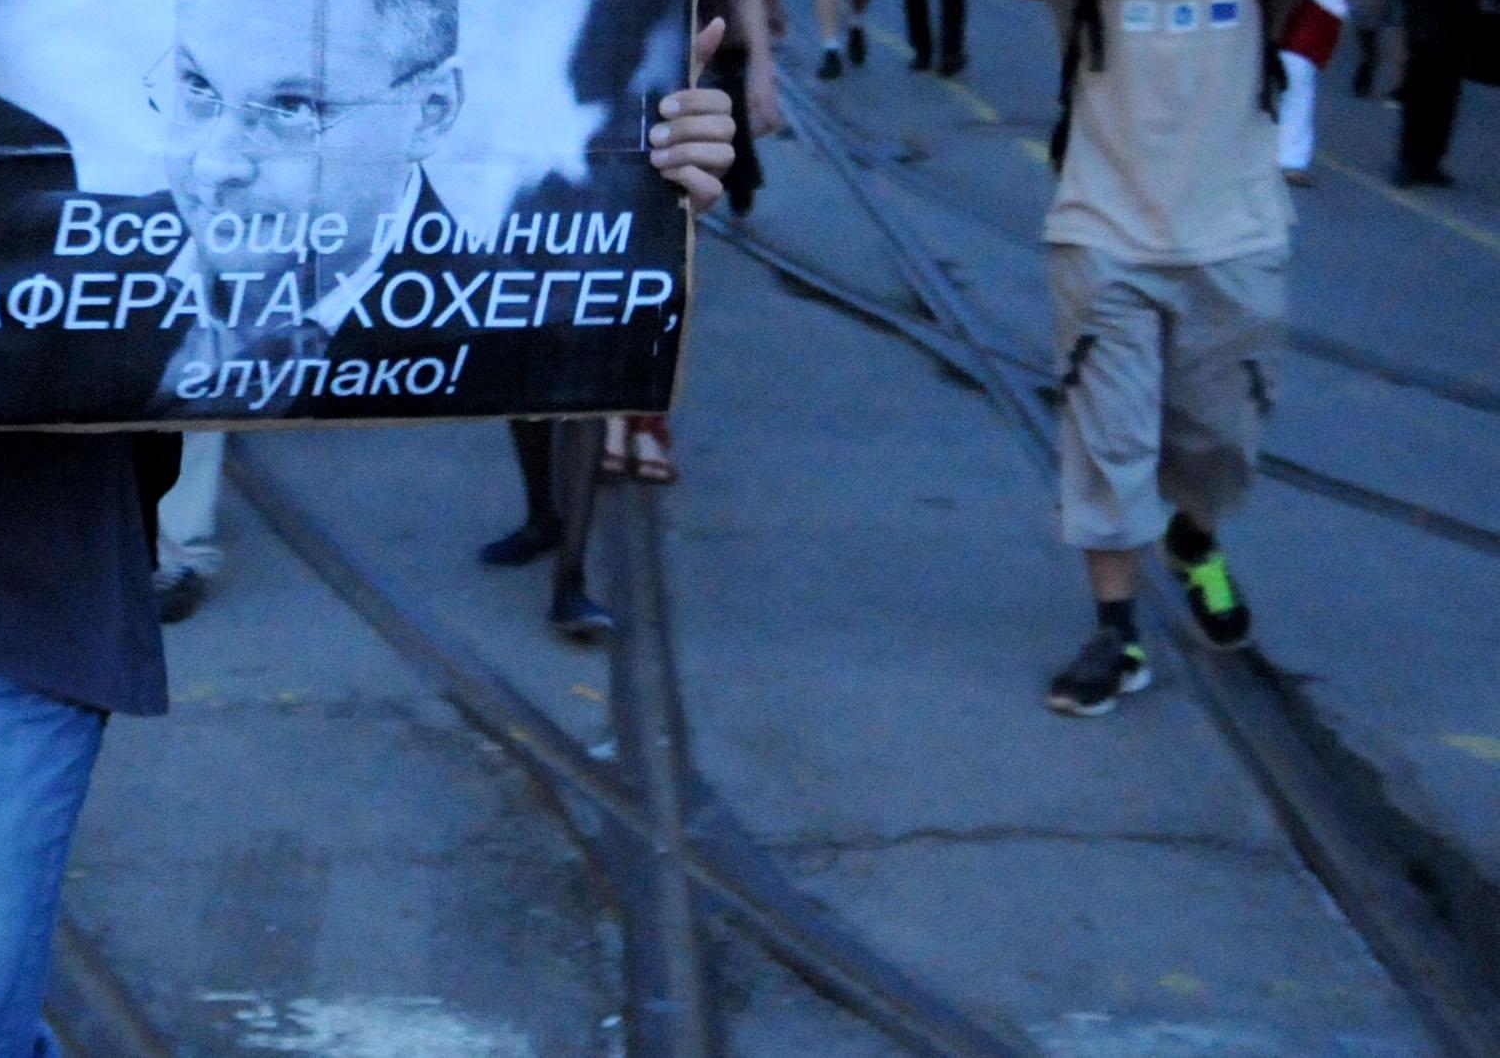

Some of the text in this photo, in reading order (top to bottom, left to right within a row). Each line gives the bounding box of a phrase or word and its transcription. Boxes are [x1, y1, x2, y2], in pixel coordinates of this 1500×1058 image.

[54, 199, 634, 265] Все още помним
[330, 269, 682, 334] ХОХЕГЕР,
[175, 344, 472, 409] глупако!
